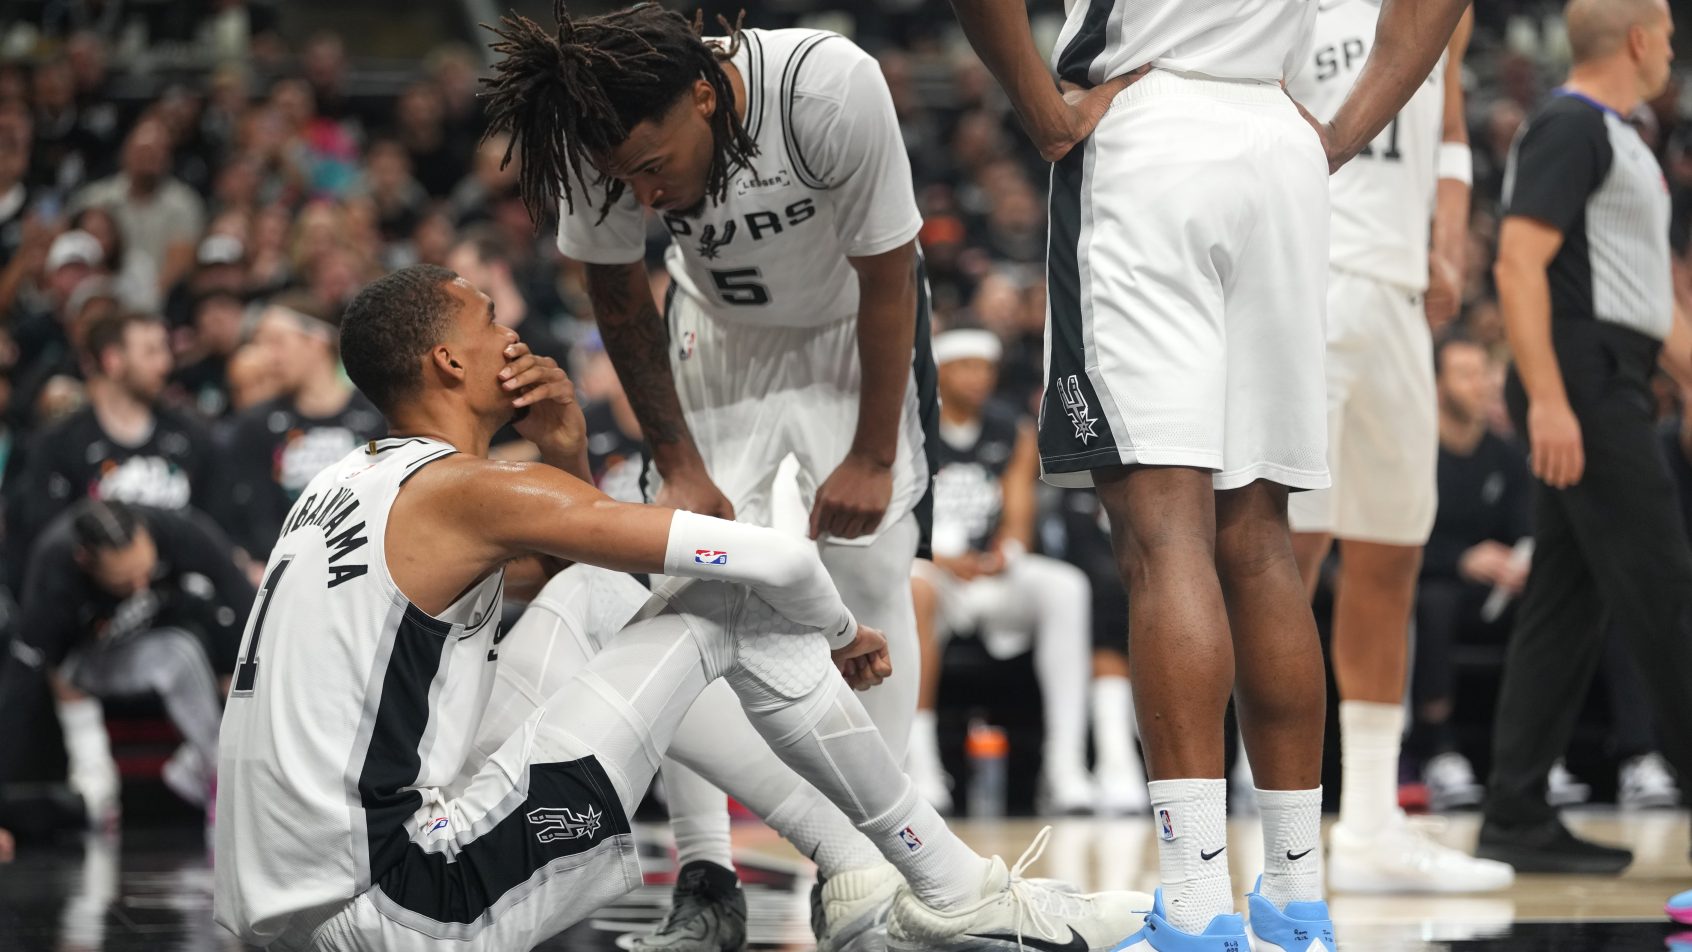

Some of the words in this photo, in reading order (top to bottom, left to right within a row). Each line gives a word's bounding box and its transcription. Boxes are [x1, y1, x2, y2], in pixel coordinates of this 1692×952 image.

[1359, 112, 1402, 159] 1
[664, 198, 815, 260] PURS
[707, 267, 773, 307] 5
[281, 487, 368, 588] BANYAMA
[231, 554, 295, 698] 1
